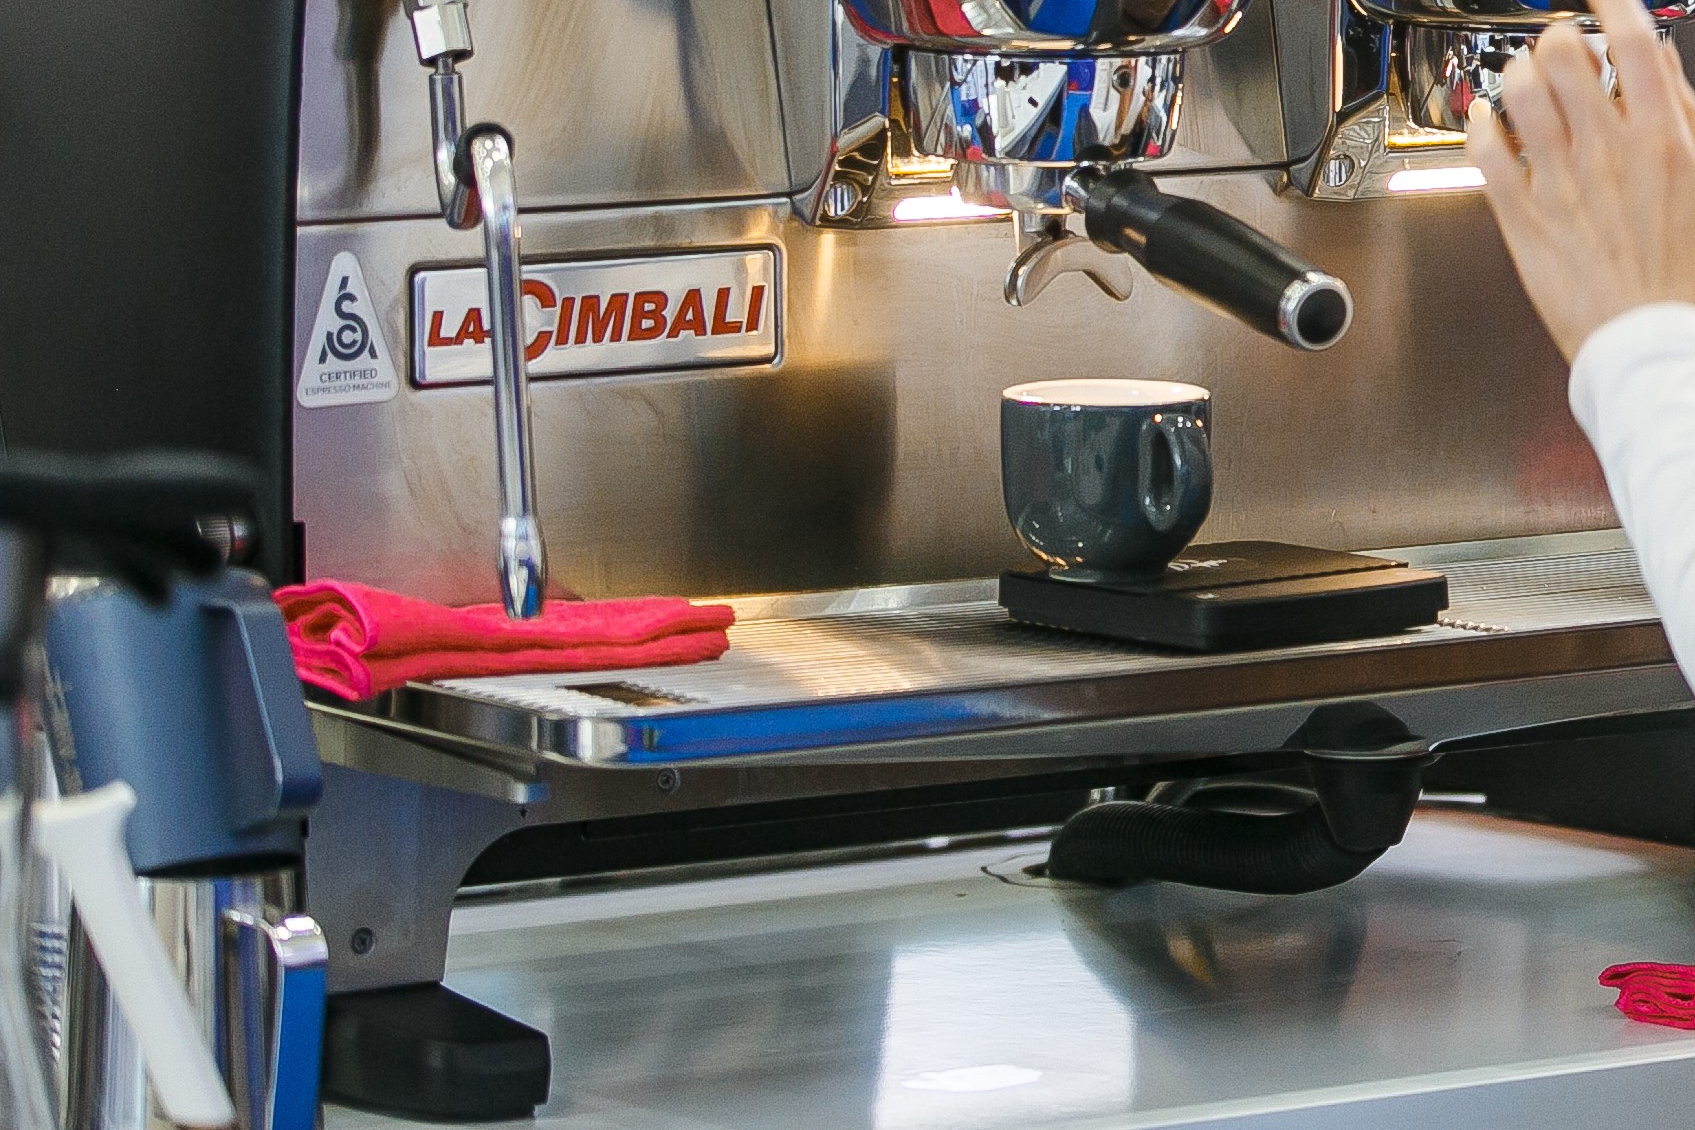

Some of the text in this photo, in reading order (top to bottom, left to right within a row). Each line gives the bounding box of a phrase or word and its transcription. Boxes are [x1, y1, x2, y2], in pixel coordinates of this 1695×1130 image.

[319, 367, 378, 383] CERTIFIED
[305, 380, 392, 396] ESPRESSO MACHINE
